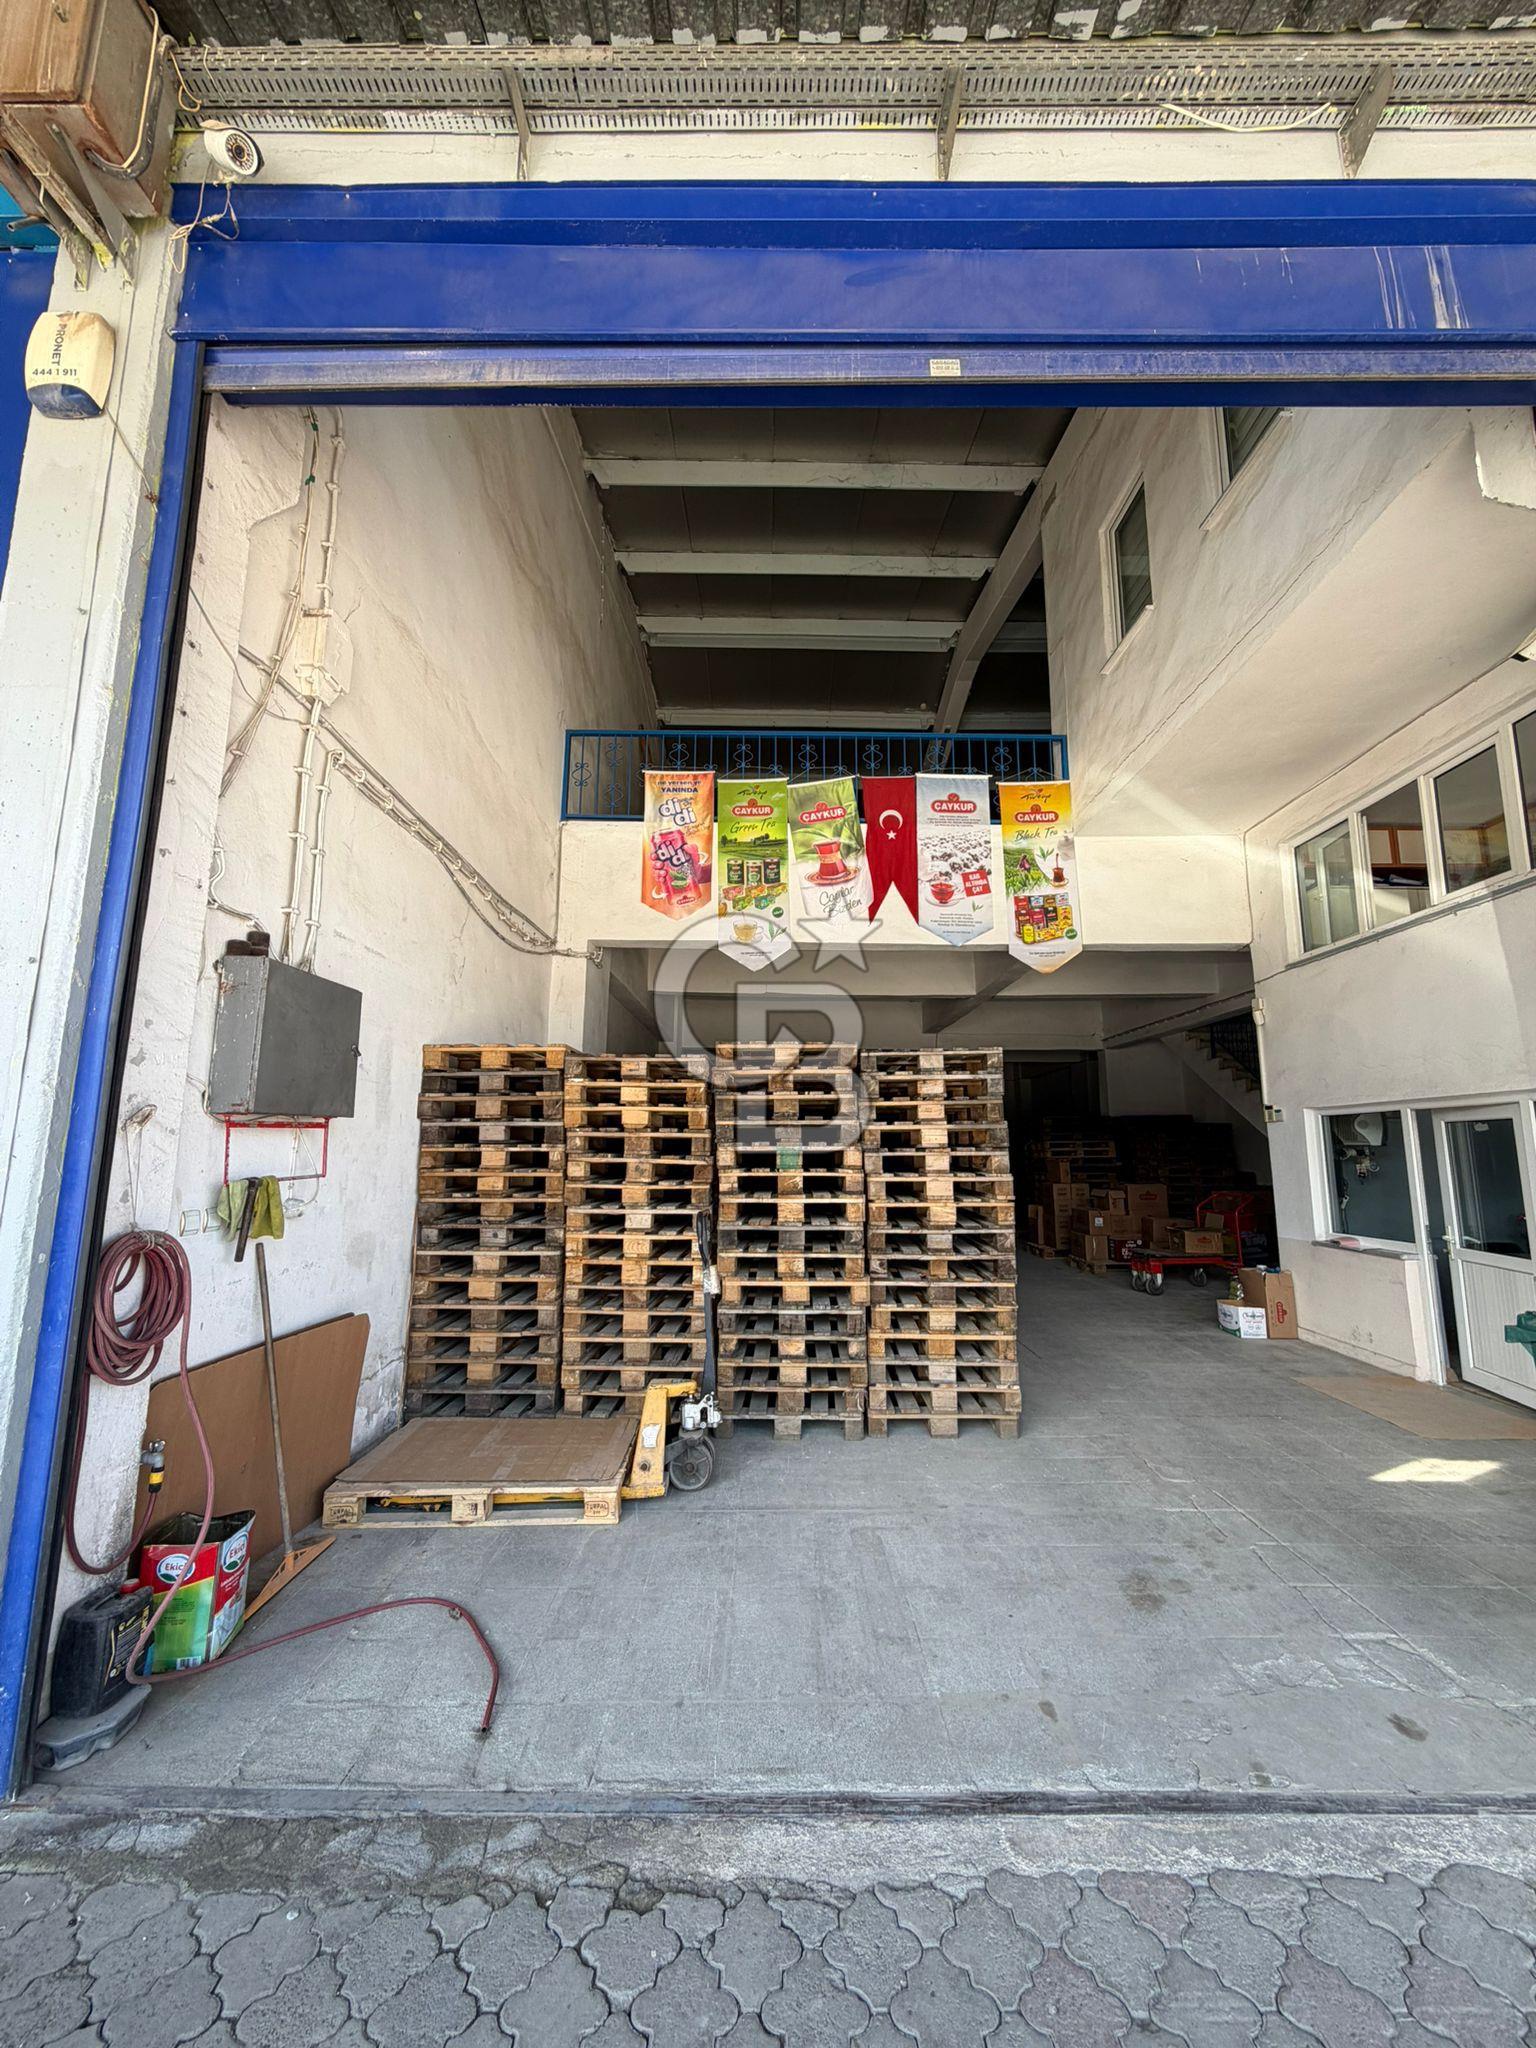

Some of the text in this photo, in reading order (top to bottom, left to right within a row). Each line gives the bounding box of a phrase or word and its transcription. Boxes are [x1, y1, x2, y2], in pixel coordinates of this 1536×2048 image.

[51, 323, 67, 366] PRONET
[32, 368, 52, 376] 444
[62, 368, 77, 376] 911
[730, 821, 759, 834] Green
[760, 817, 777, 832] Tea
[1014, 826, 1058, 843] Black Tea
